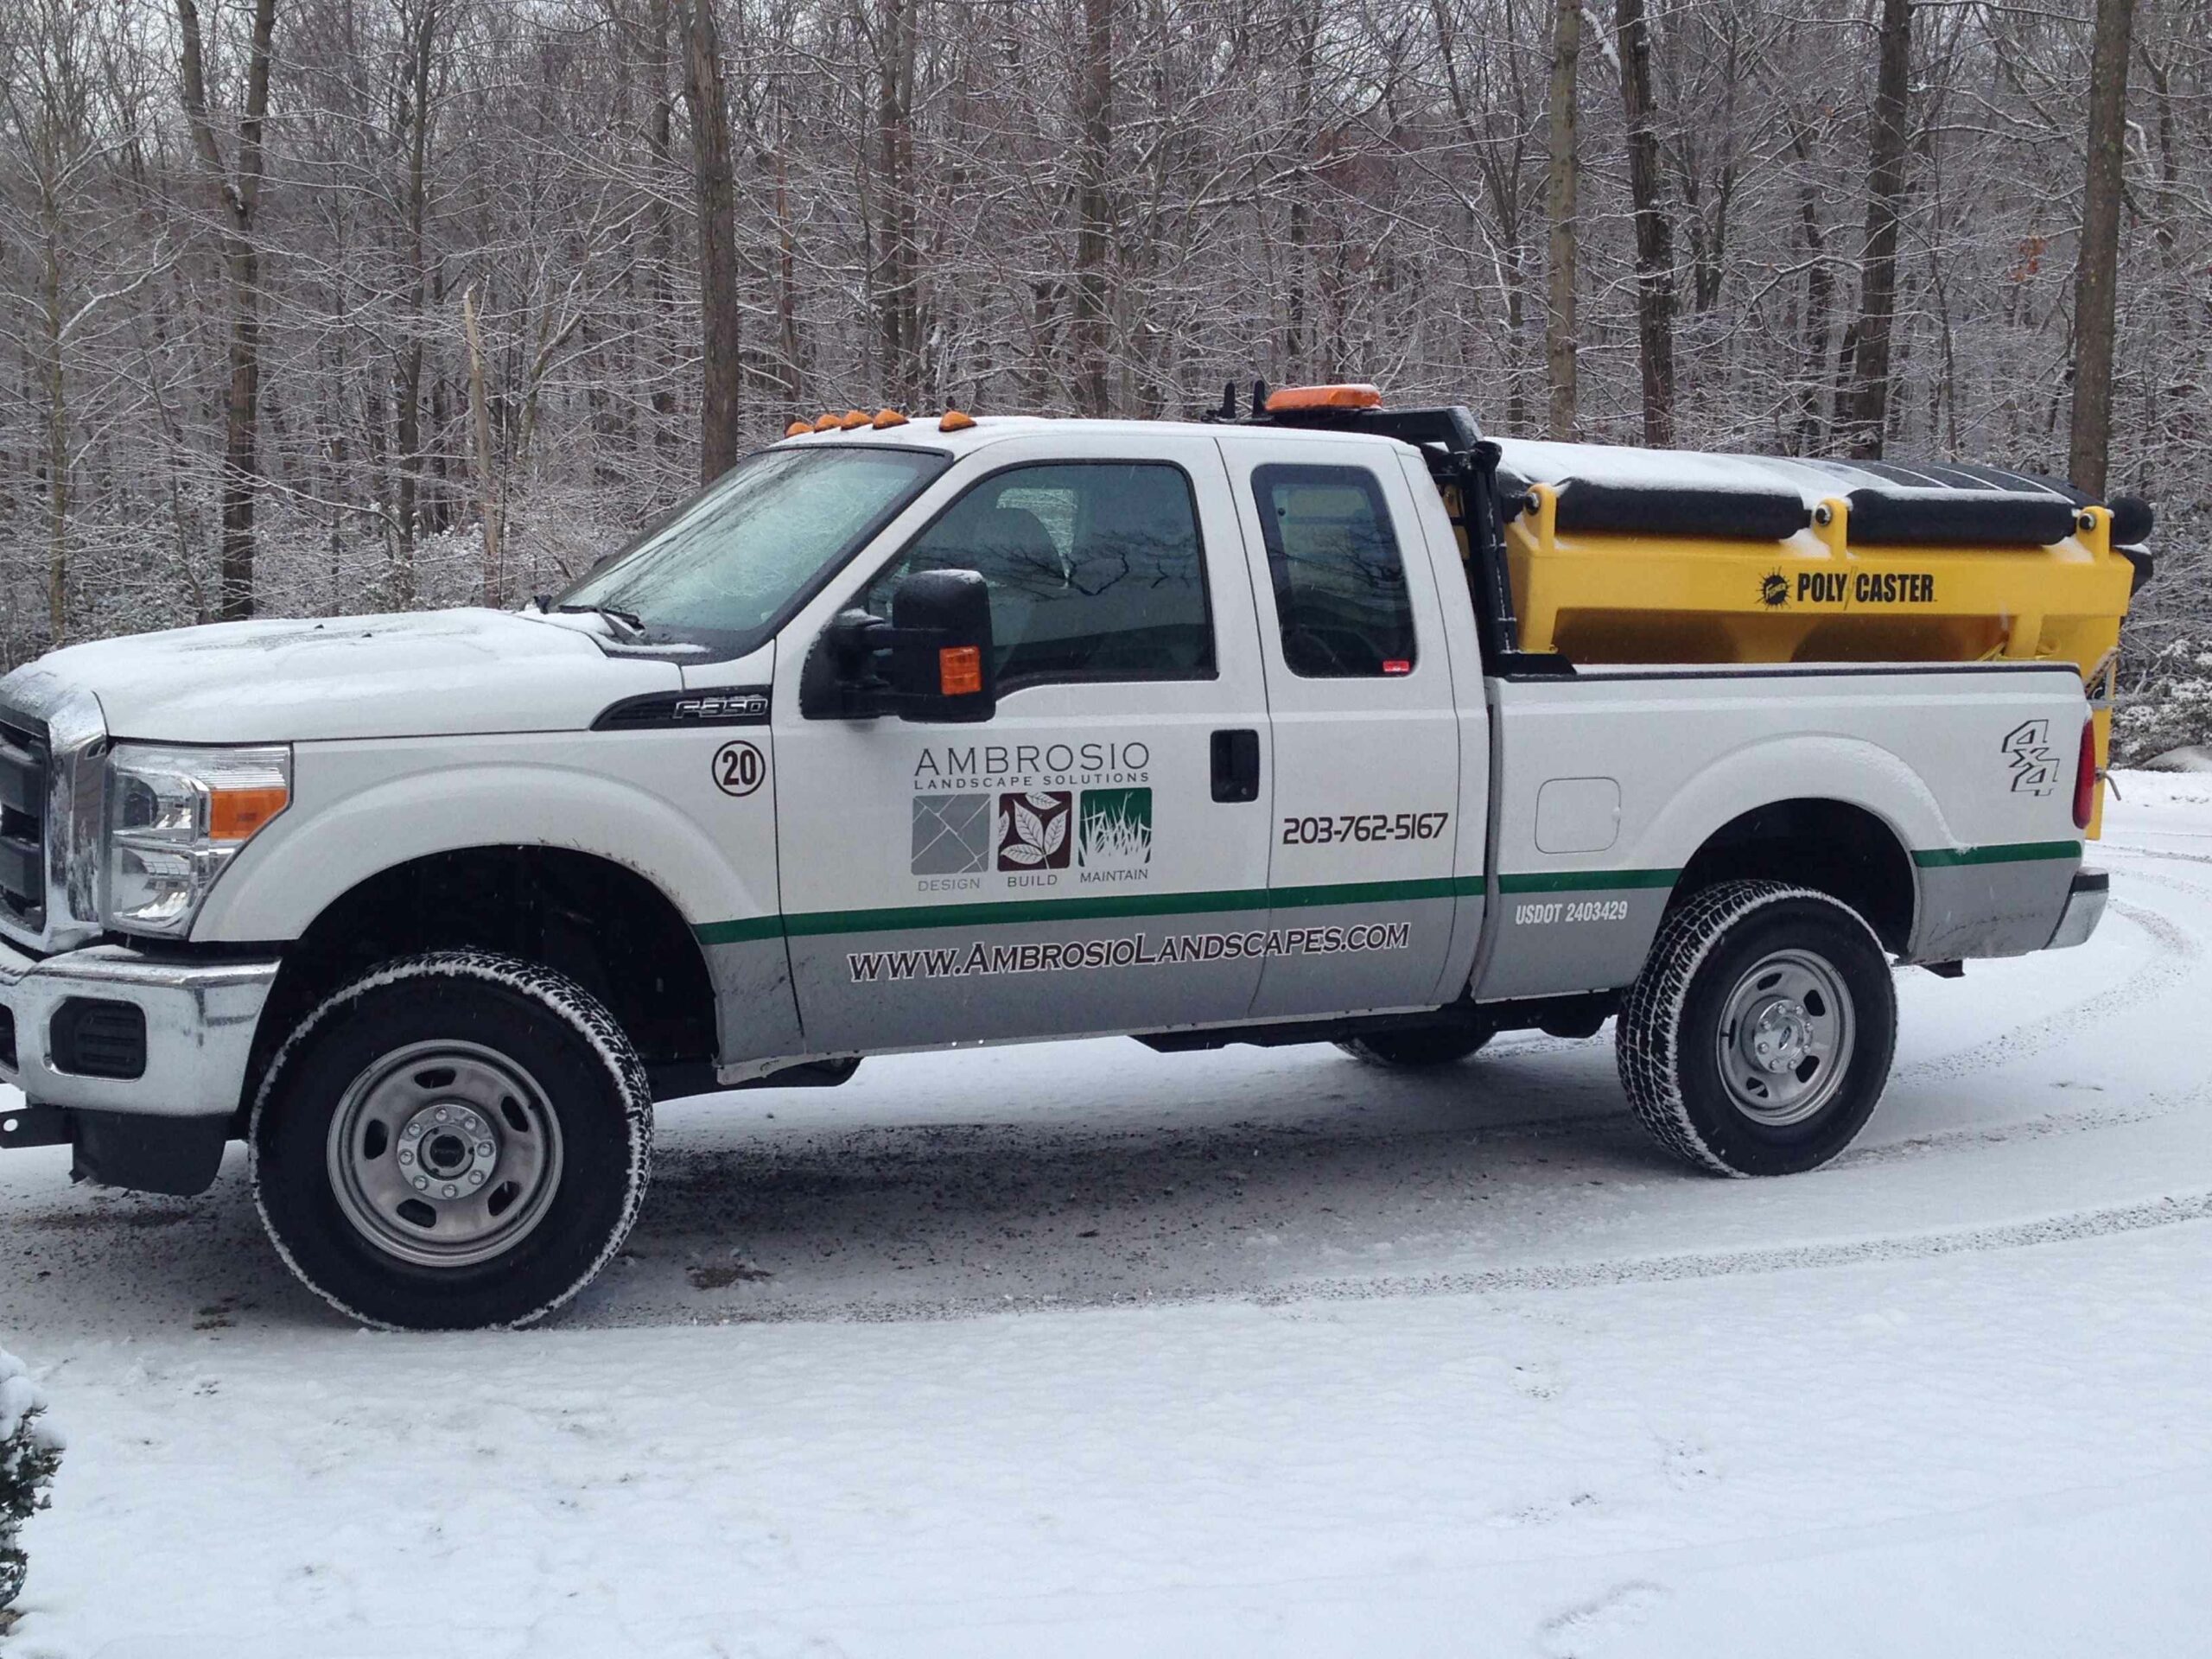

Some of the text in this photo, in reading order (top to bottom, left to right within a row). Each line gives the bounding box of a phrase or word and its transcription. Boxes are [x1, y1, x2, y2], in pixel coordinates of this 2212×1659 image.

[1797, 573, 1847, 602] POLY
[1855, 573, 1934, 602] CASTER
[722, 749, 756, 785] 20
[914, 742, 1149, 777] AMBROSIO
[914, 772, 1150, 791] LANDSCAPE SOLUTIONS
[1282, 812, 1449, 844] 203-762-5167
[918, 868, 1149, 893] DESIGN BUILD MAINTAIN
[1516, 900, 1628, 925] USDOT 2403429
